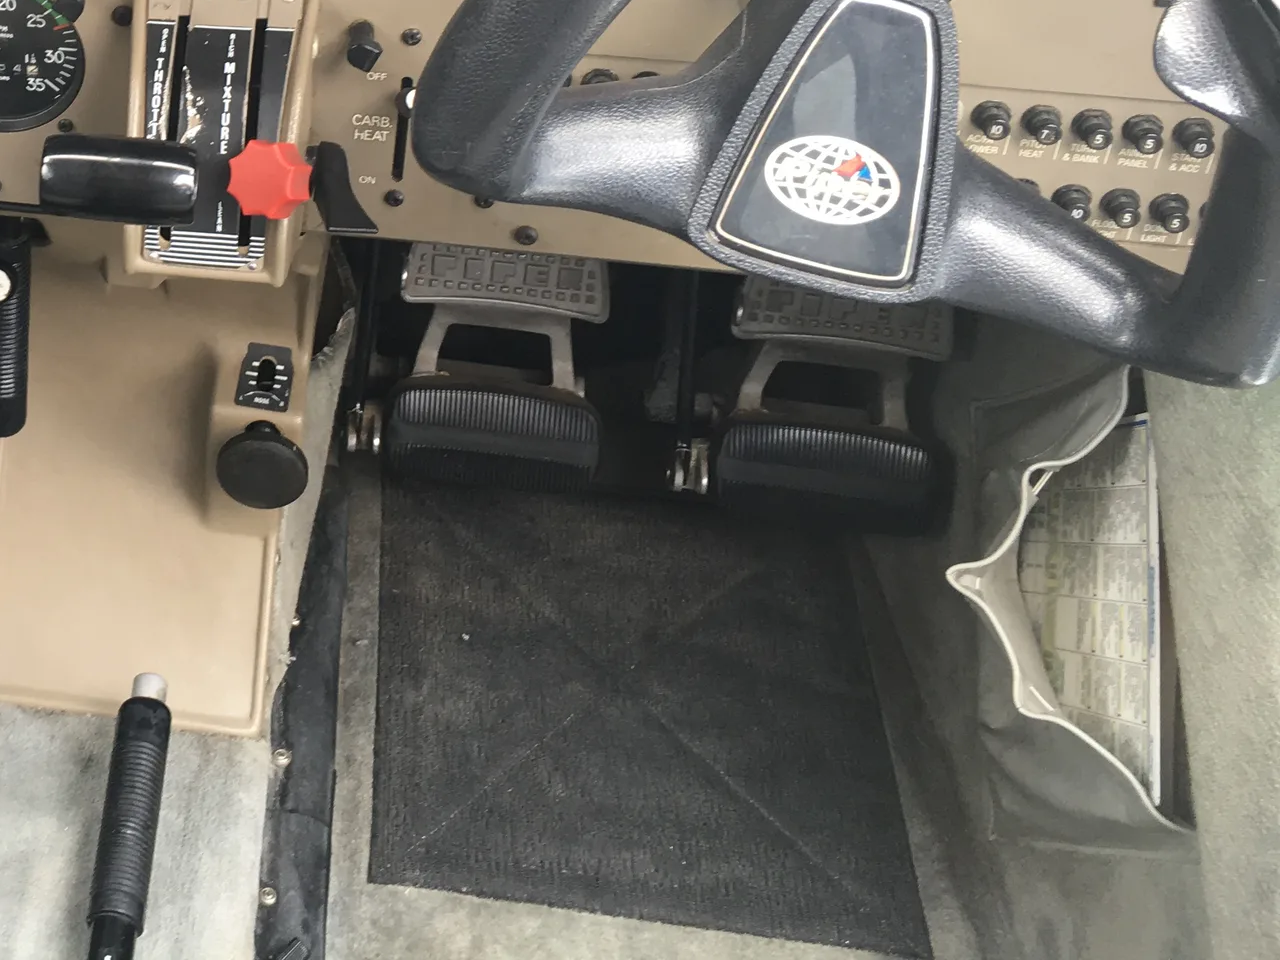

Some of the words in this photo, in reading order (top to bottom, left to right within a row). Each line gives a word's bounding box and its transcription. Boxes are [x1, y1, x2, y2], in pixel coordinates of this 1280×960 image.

[27, 14, 46, 27] 25
[160, 28, 169, 53] OPEN
[228, 33, 236, 58] RICH
[44, 50, 64, 63] 30
[366, 72, 387, 80] OFF
[26, 78, 46, 91] 35
[147, 58, 164, 140] THROTT
[221, 62, 236, 154] MIXTURE
[352, 114, 392, 128] CARB.
[989, 125, 1003, 134] 10
[354, 130, 390, 142] HEAT
[969, 144, 998, 154] OWER
[1019, 149, 1043, 157] HEAT
[1194, 143, 1207, 152] 10
[1062, 153, 1069, 161] &
[1071, 154, 1099, 163] BANK
[1119, 158, 1148, 168] PANEL
[1179, 164, 1200, 172] ACC
[359, 176, 376, 184] ON
[1142, 234, 1167, 242] LIGHT
[430, 253, 585, 291] PIPER
